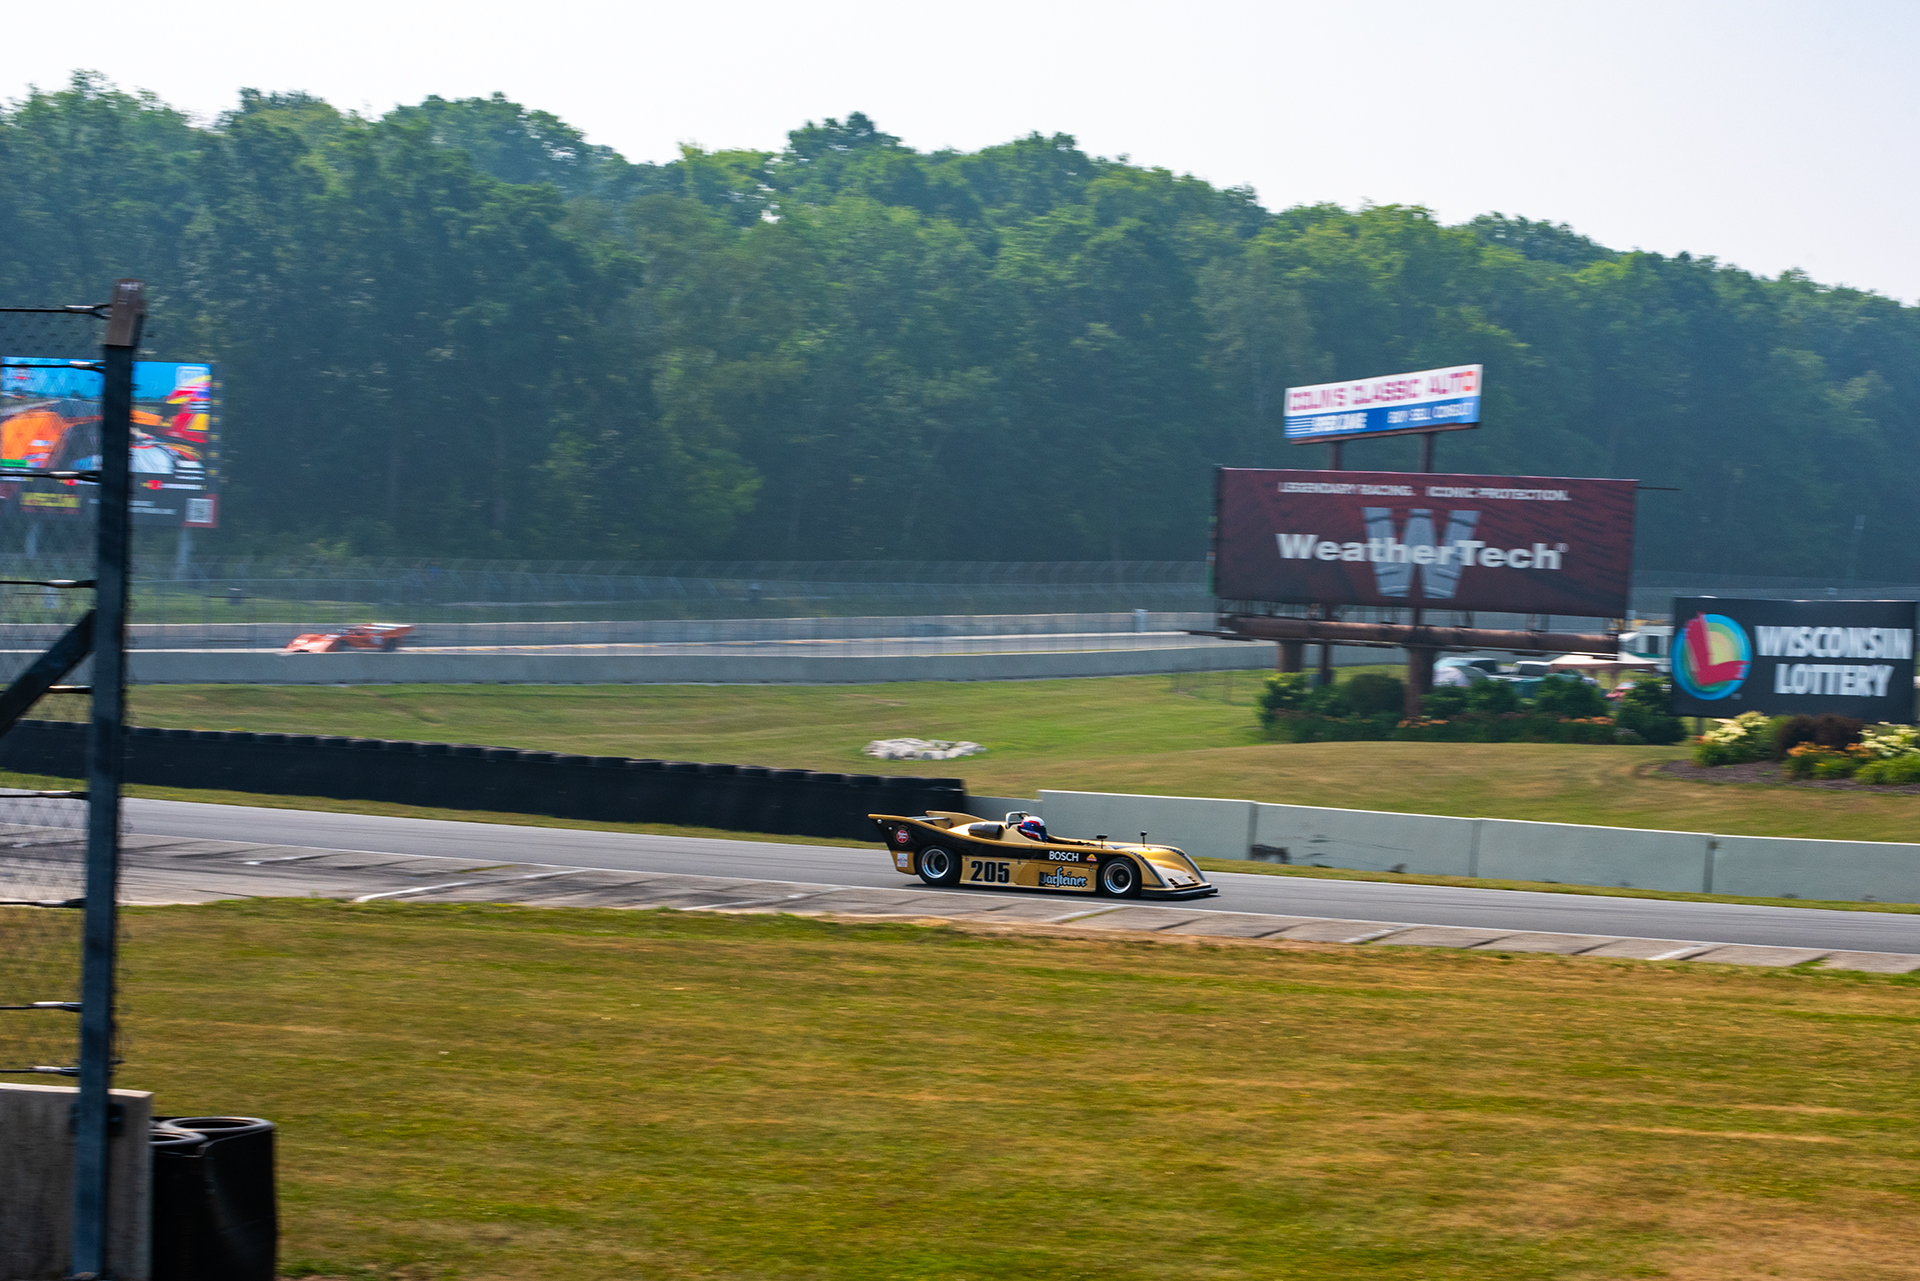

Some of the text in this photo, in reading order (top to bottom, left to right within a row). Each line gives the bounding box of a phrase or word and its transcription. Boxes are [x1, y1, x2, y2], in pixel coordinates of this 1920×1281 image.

[1352, 379, 1422, 405] CLASSIC
[1425, 370, 1478, 396] AUTO
[1278, 482, 1356, 494] LEGENDARY
[1425, 486, 1477, 498] ICONIC
[1275, 533, 1563, 570] WeatherTech
[1754, 625, 1914, 660] WISCONSIN
[1773, 663, 1895, 697] LOTTERY
[970, 860, 1010, 884] 205
[1049, 851, 1079, 862] BOSCH
